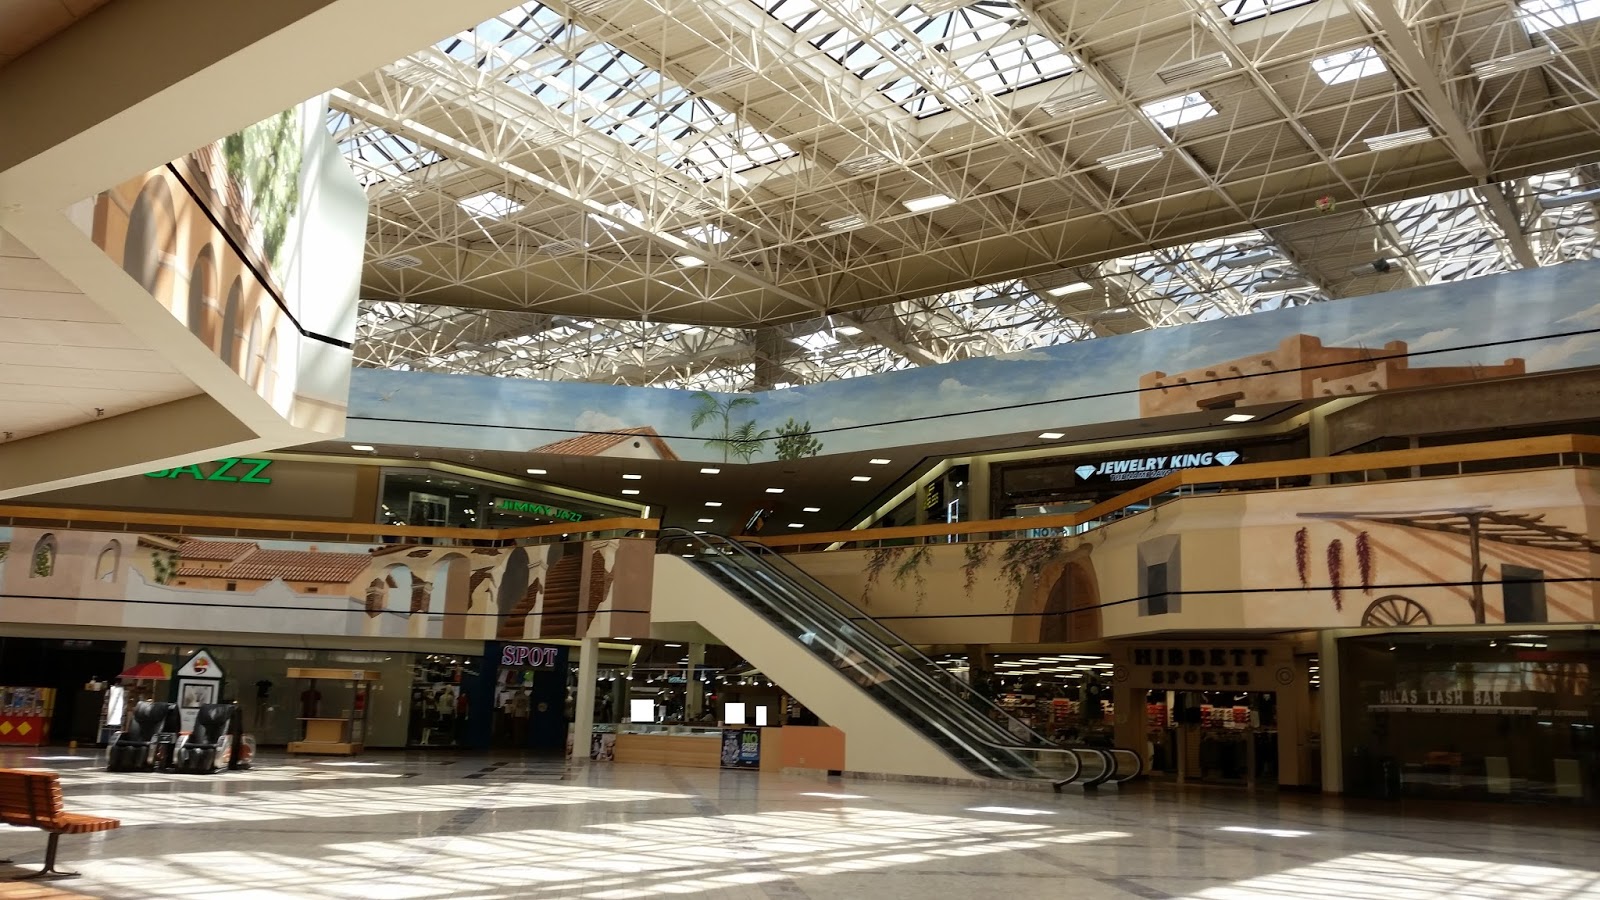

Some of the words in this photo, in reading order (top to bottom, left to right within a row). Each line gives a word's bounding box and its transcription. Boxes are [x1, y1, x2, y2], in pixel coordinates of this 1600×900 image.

[1096, 456, 1168, 475] JEWELRY
[1170, 451, 1213, 468] KING
[501, 499, 551, 515] JIMMY
[555, 508, 583, 522] JAZZ
[501, 644, 558, 667] SPOT
[1134, 648, 1268, 666] HIBBETT
[1151, 670, 1250, 686] SPORTS
[1427, 690, 1464, 705] LASH
[1473, 691, 1503, 705] BAR
[742, 733, 758, 743] NO
